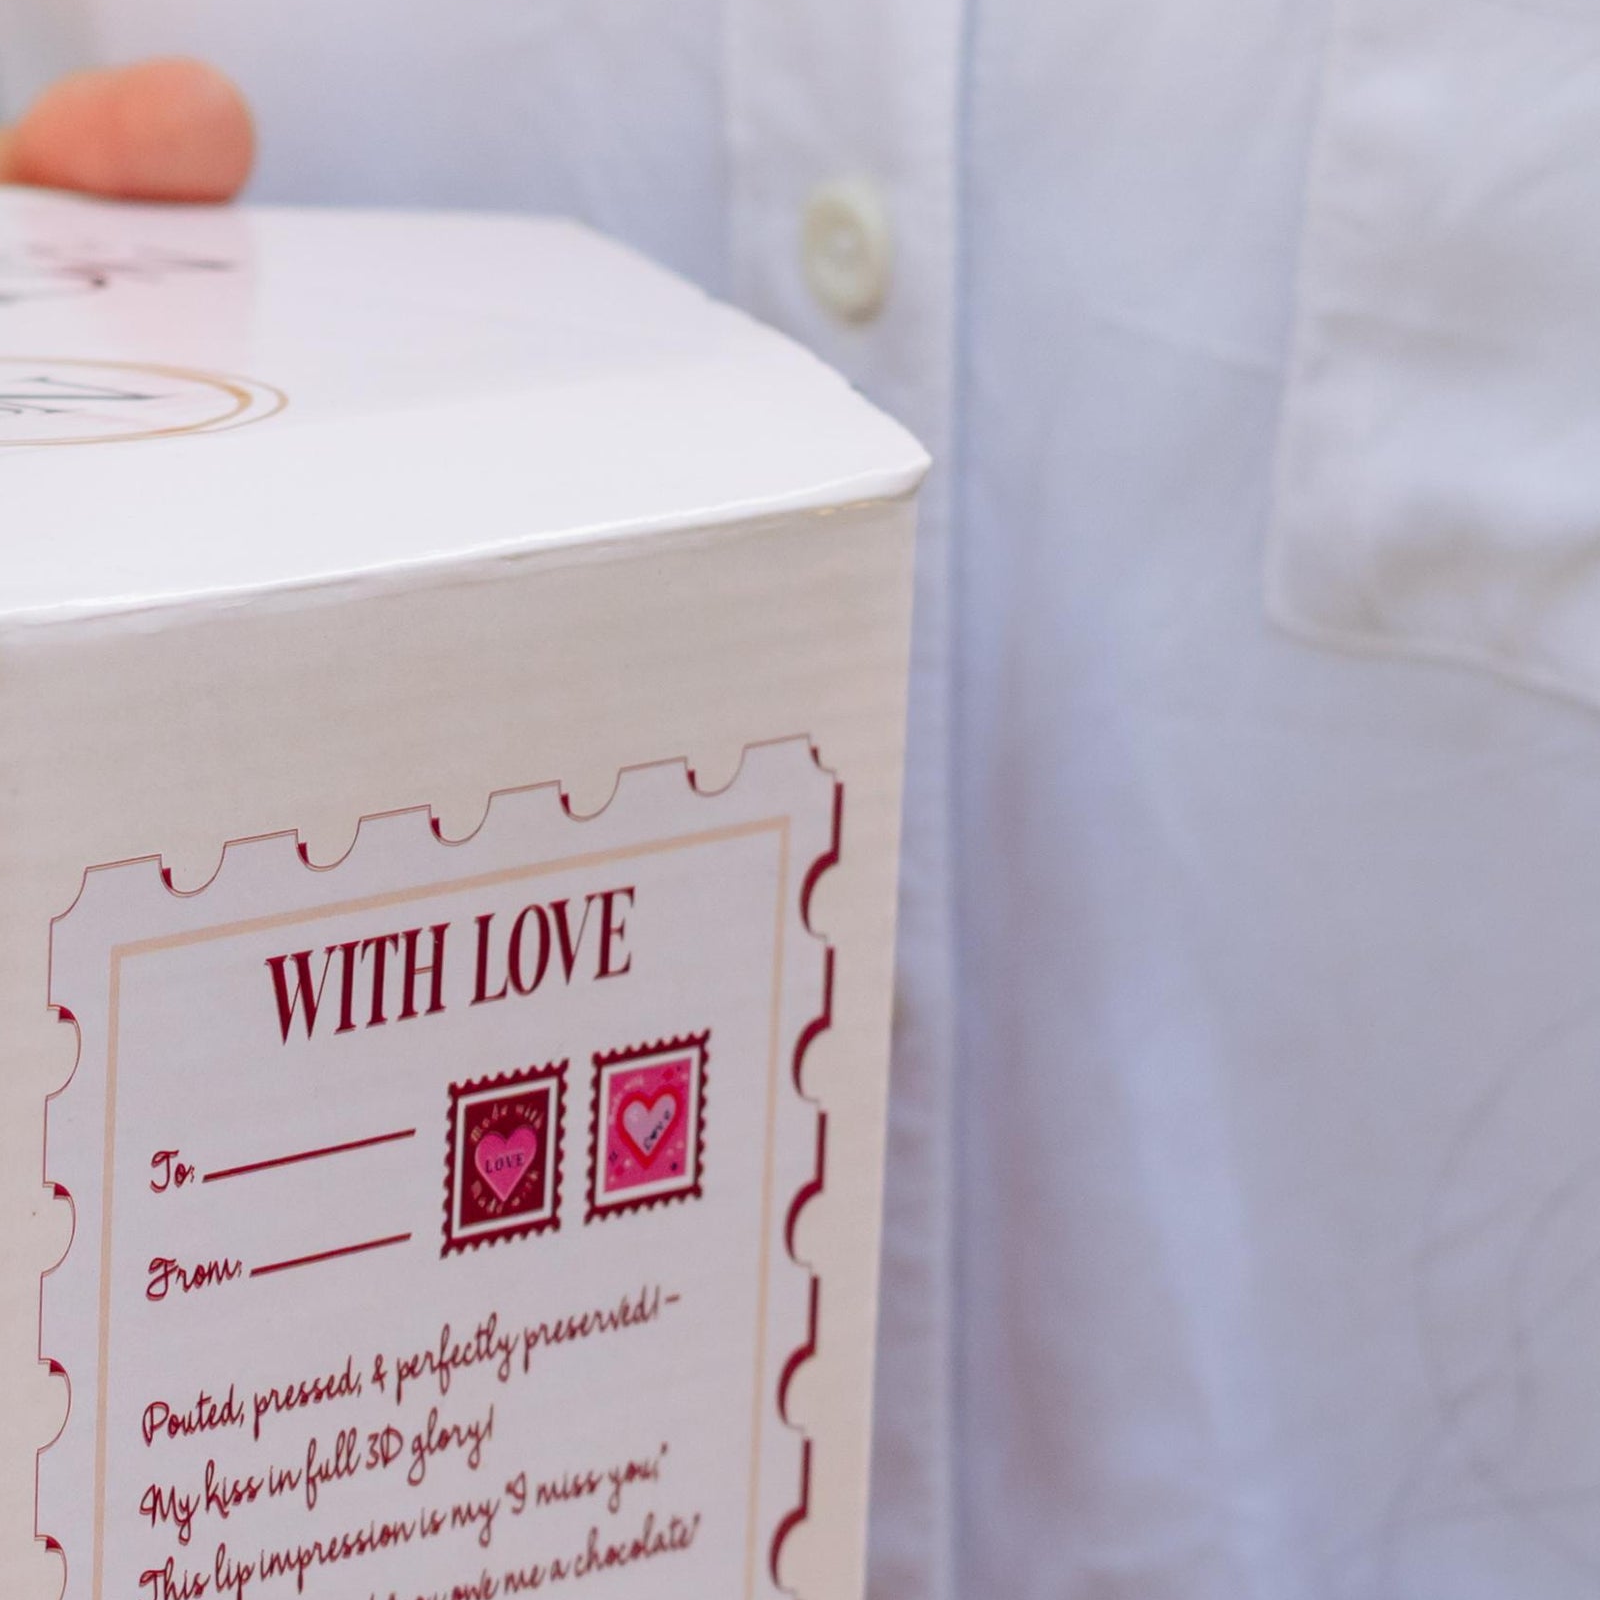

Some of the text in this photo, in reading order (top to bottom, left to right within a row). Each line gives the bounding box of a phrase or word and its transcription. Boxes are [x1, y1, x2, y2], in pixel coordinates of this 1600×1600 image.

[265, 886, 636, 1045] WITH LOVE
[149, 1150, 197, 1193] To:
[484, 1152, 525, 1174] LOVE
[145, 1256, 244, 1301] From:
[142, 1385, 246, 1446] Pouted,
[253, 1355, 362, 1442] pressed,
[371, 1353, 389, 1385] &
[396, 1312, 519, 1405] perfectly
[139, 1404, 495, 1545] My kiss in full 3D glory!
[259, 1517, 413, 1593] impression
[420, 1506, 447, 1538] is
[451, 1497, 501, 1548] my
[536, 1469, 602, 1506] miss
[504, 1564, 547, 1594] me
[550, 1558, 570, 1582] a
